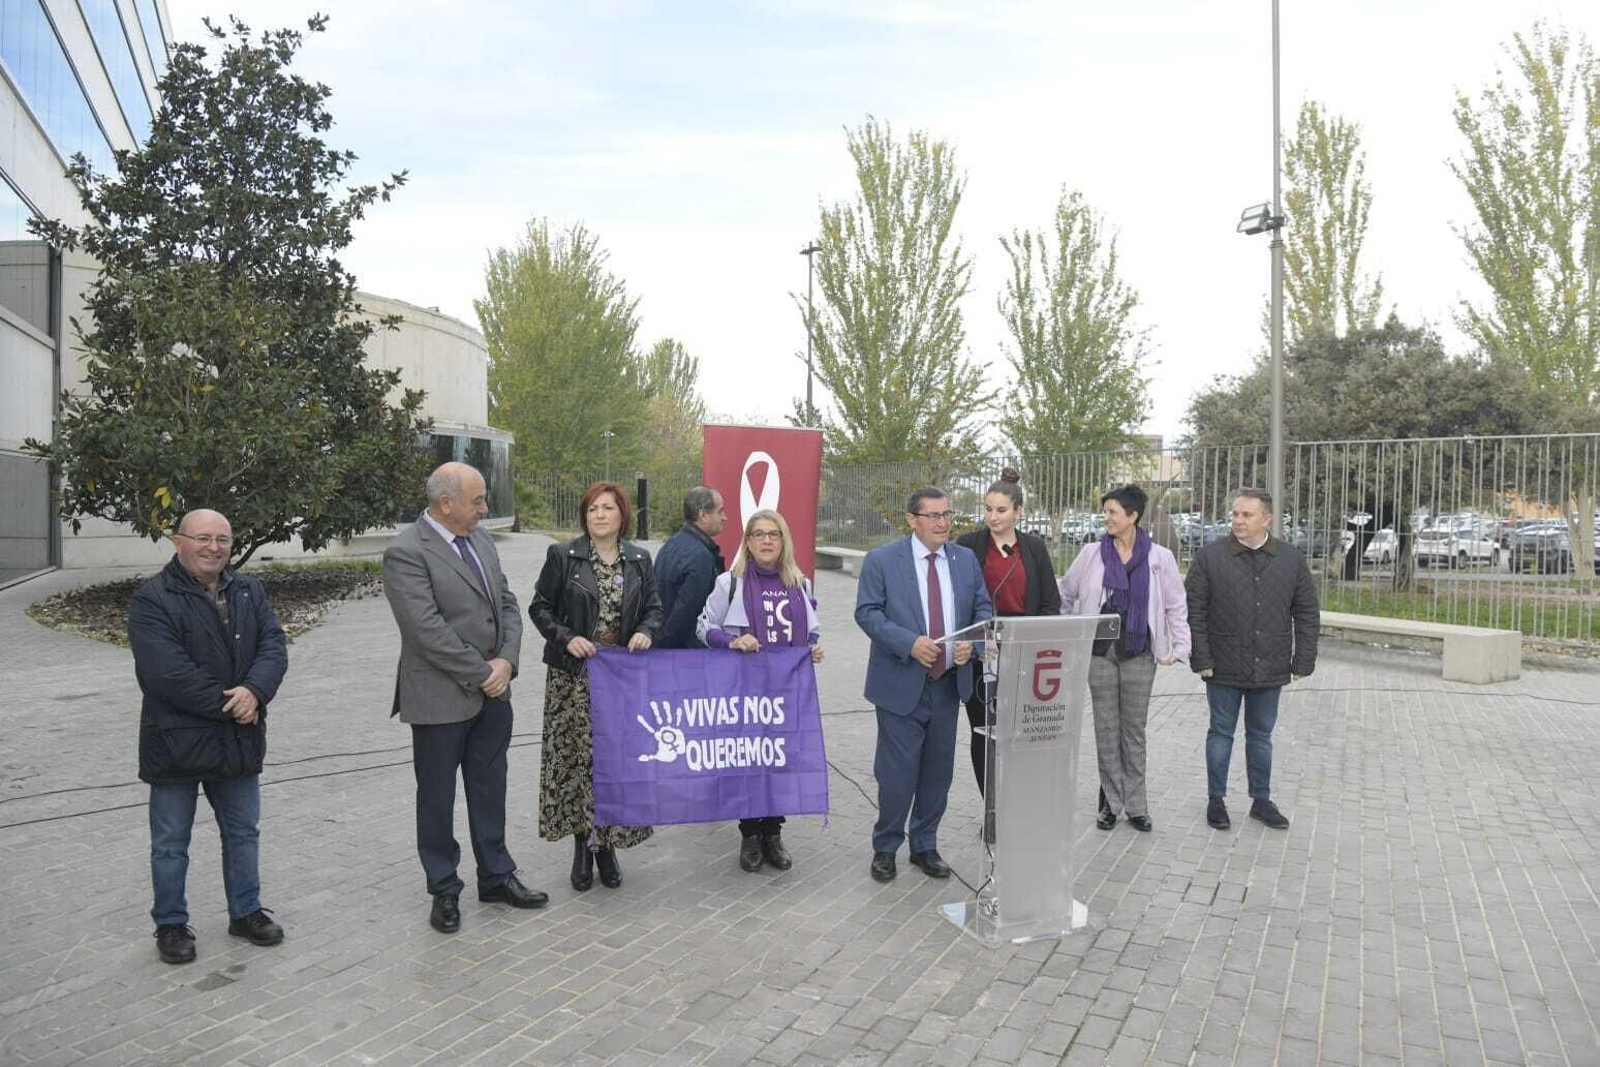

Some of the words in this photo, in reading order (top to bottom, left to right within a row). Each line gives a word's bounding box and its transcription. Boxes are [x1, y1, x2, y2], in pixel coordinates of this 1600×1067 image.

[683, 696, 739, 727] VIVAS
[743, 696, 785, 725] NOS
[1021, 714, 1031, 724] de
[1032, 712, 1065, 723] Granada
[1023, 703, 1066, 713] Diputación
[685, 736, 787, 772] QUEREMOS
